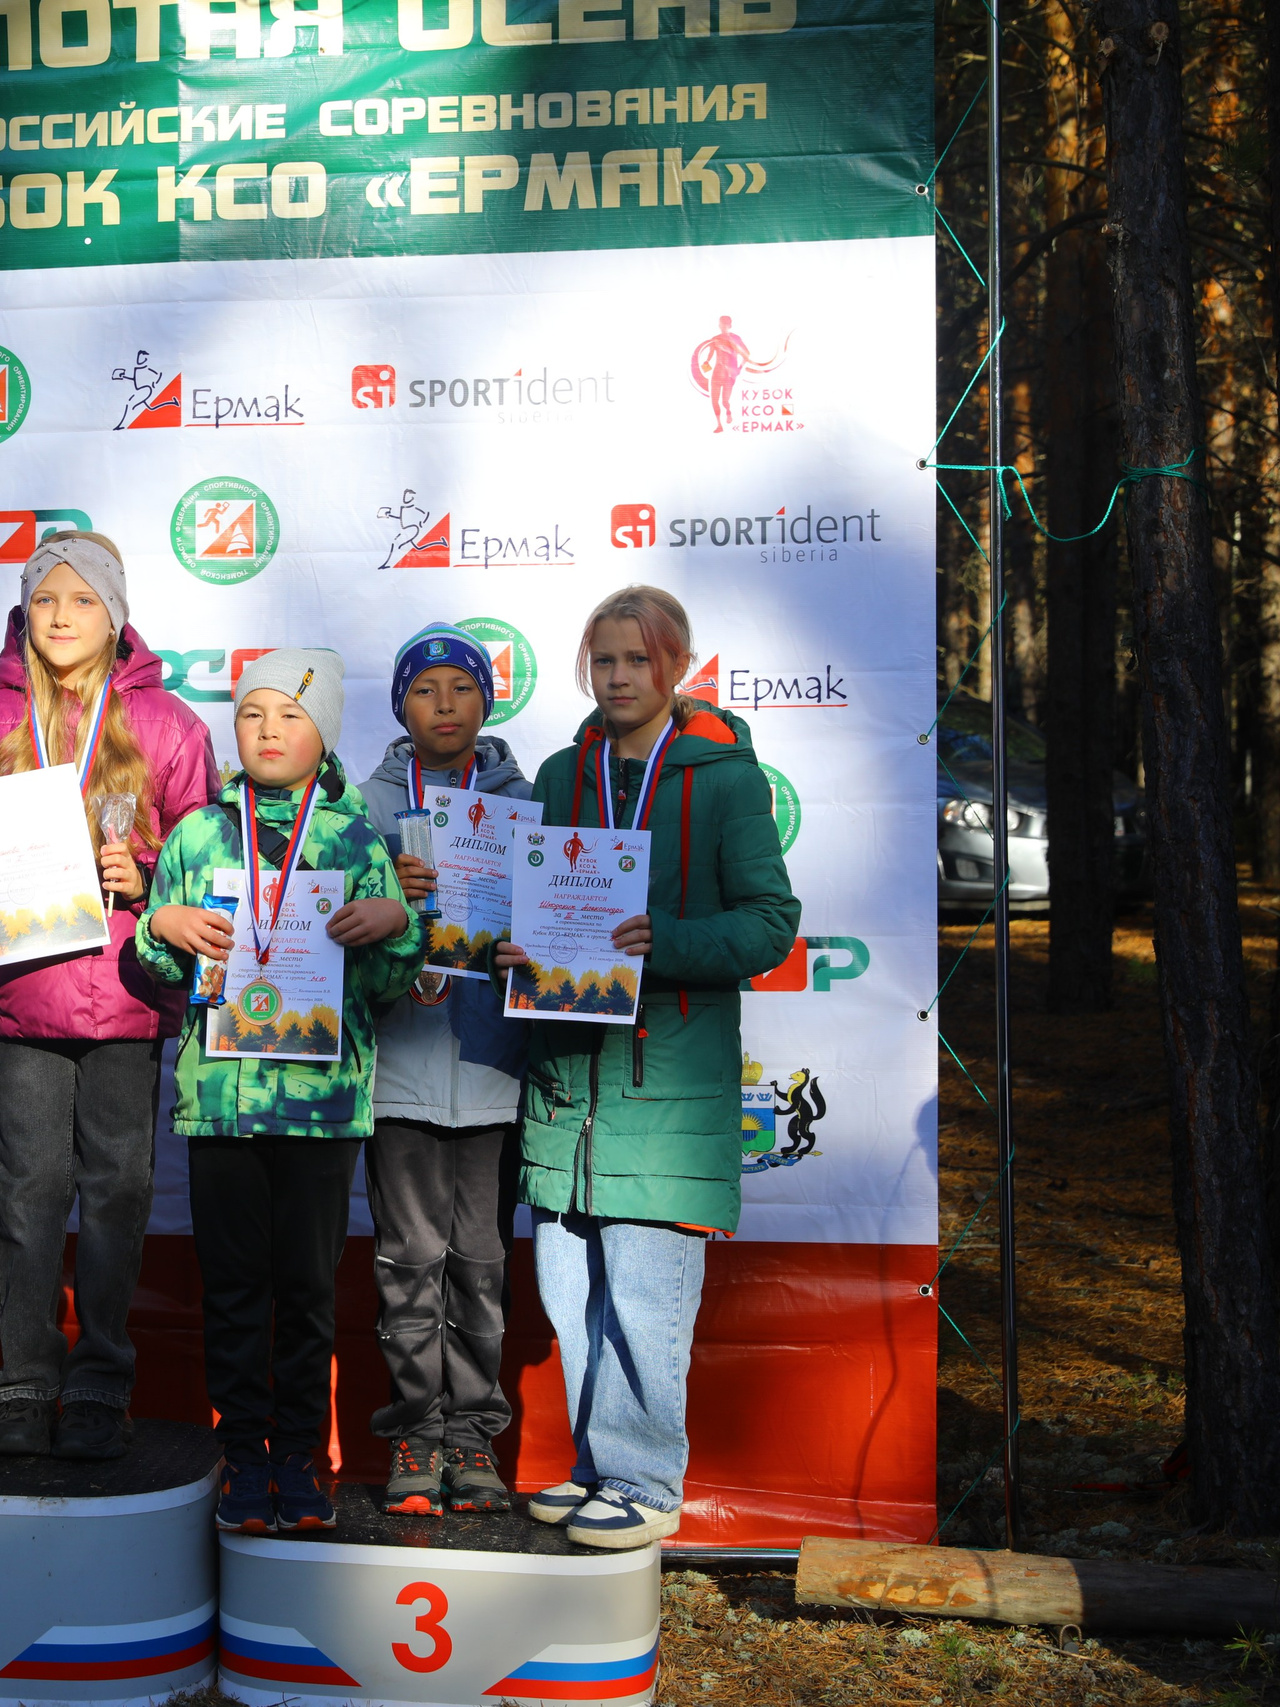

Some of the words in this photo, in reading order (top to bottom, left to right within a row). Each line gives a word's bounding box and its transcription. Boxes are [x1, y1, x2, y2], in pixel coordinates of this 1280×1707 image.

[319, 82, 768, 137] СОРЕВНОВАНИЯ
[157, 161, 327, 223] КСО
[365, 146, 767, 215] «ЕРМАК»
[741, 389, 793, 401] КУБОК
[192, 384, 304, 428] Ермак
[741, 405, 774, 416] КСО
[732, 420, 805, 432] «ЕРМАК»
[669, 505, 881, 548] SPORTident
[461, 524, 574, 569] Ермак
[760, 545, 838, 563] siberia
[730, 665, 847, 711] Ермак
[450, 836, 507, 855] ДИПЛОМ
[454, 854, 501, 867] НАГРАЖДАЕТСЯ
[548, 875, 613, 888] ДИПЛОМ
[554, 893, 607, 902] НАГРАЖДАЕТСЯ
[391, 1581, 453, 1674] 3
